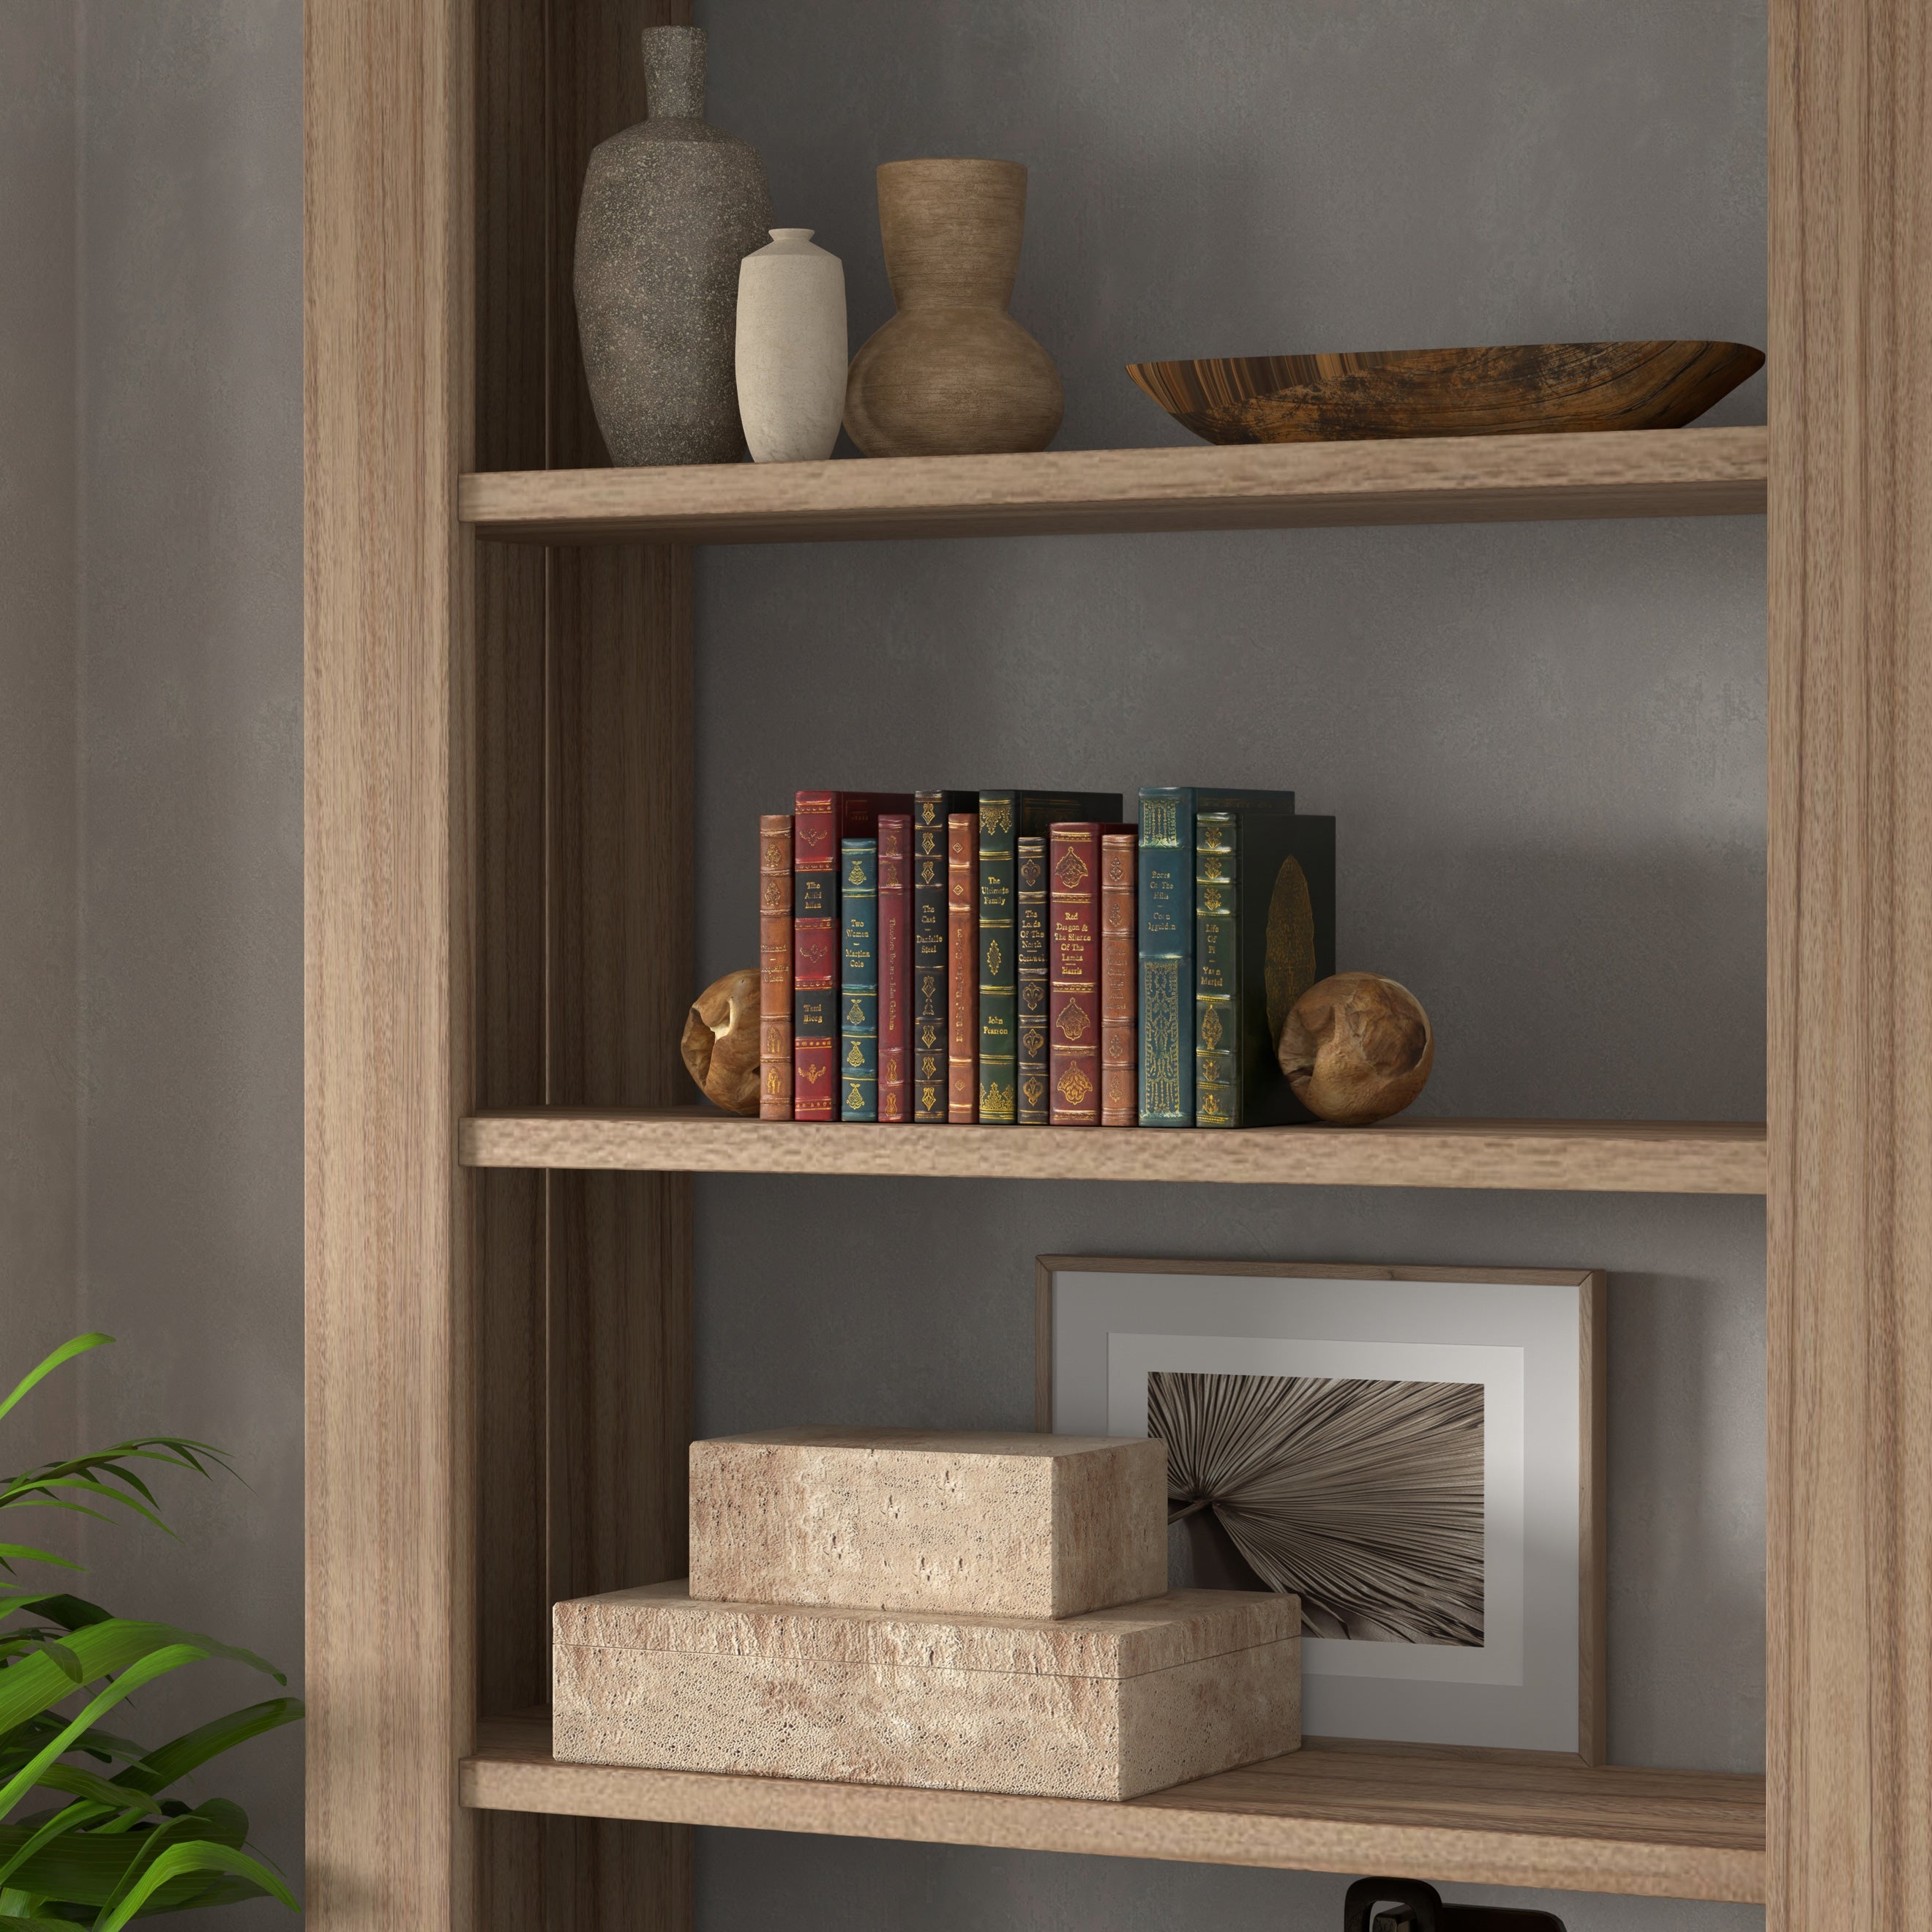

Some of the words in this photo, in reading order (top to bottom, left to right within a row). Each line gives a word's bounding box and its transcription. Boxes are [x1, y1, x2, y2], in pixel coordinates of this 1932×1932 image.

[984, 896, 1006, 905] Family
[922, 905, 935, 913] The
[1025, 910, 1038, 918] The
[851, 919, 864, 927] Two
[1056, 922, 1080, 932] Dragon
[1147, 922, 1177, 932] Igguldn
[1205, 924, 1220, 933] Life
[846, 929, 869, 937] Women
[1020, 930, 1030, 938] Of
[1055, 932, 1066, 940] The
[1208, 946, 1216, 954] Pi
[1061, 954, 1083, 962] Lambs
[850, 959, 864, 967] Cole
